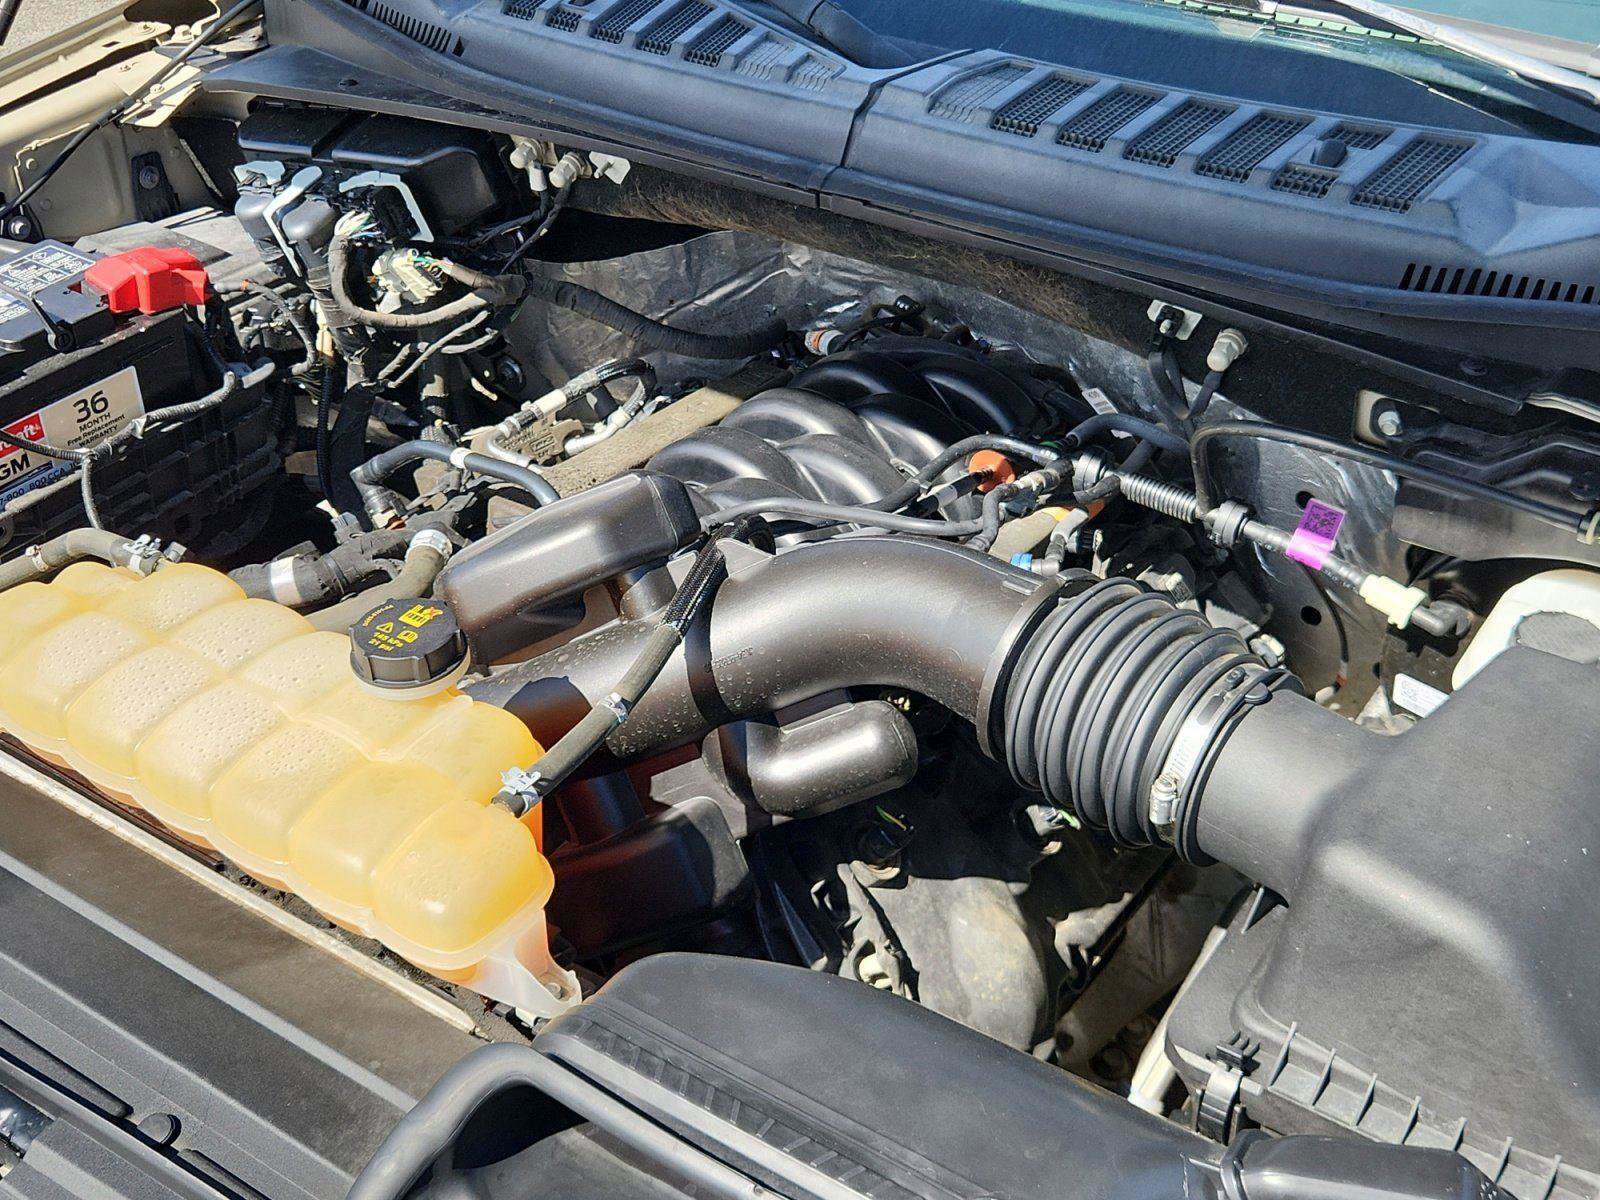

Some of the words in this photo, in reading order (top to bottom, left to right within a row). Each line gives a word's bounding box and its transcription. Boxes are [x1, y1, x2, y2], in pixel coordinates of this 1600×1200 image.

[73, 390, 109, 423] 36
[67, 435, 82, 446] Free
[82, 414, 125, 438] Replacement
[79, 412, 111, 432] MONTH
[79, 424, 118, 447] WARRANTY
[29, 476, 47, 490] 800
[47, 467, 66, 481] CCA
